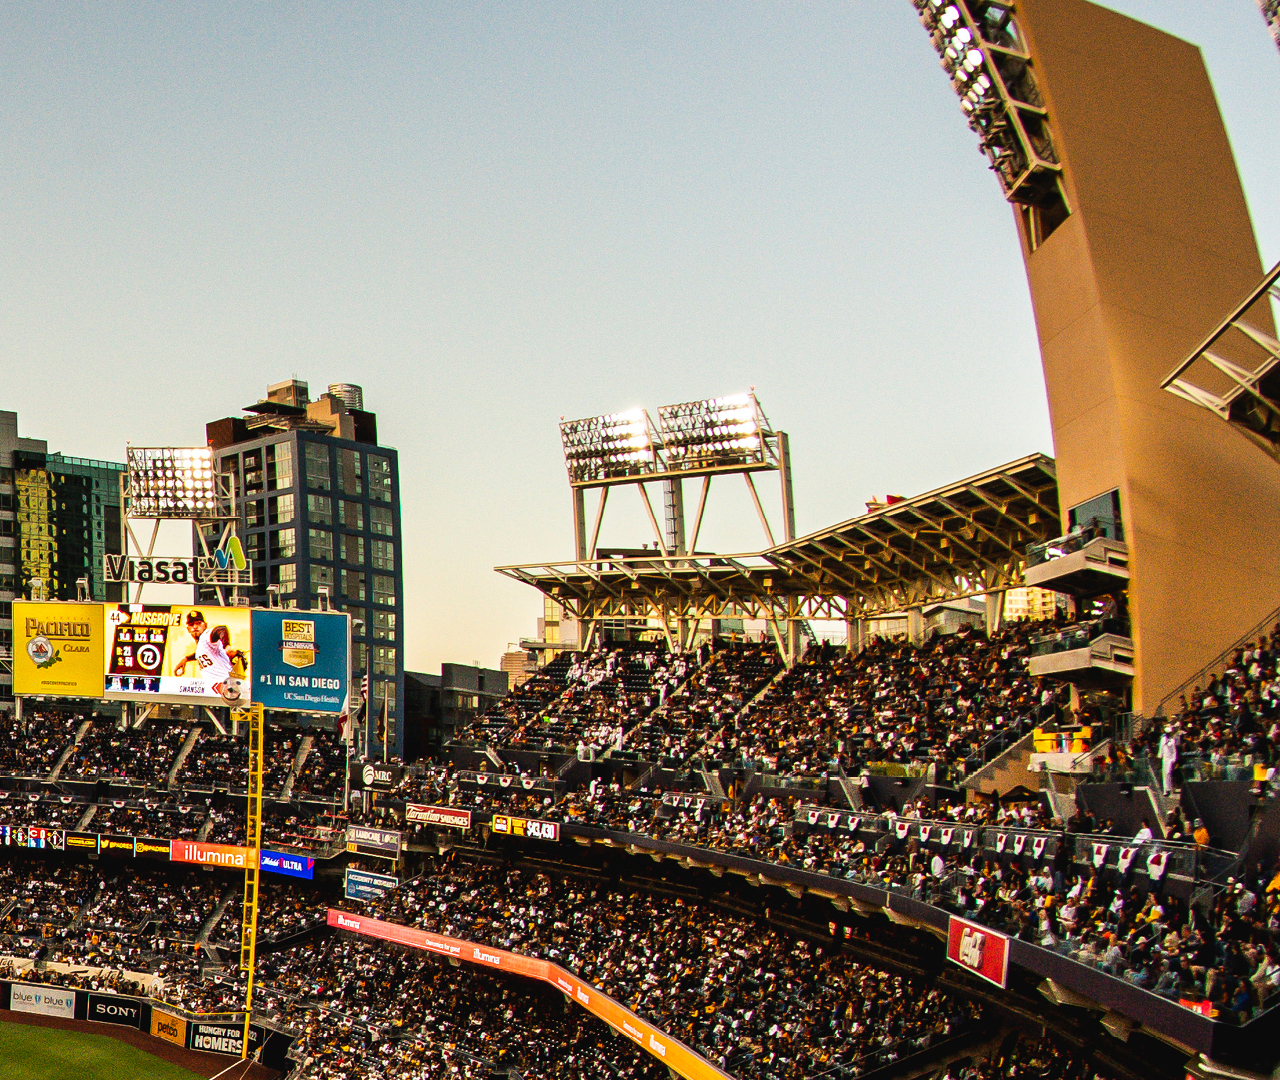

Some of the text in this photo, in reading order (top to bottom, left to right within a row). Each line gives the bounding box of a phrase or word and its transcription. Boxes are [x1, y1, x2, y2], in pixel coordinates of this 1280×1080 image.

[106, 554, 205, 584] Viasat
[109, 612, 180, 626] 44 MUSGROVE
[284, 622, 312, 634] BEST
[142, 651, 154, 664] 72
[260, 674, 340, 690] #1 IN SAN DIEGO
[179, 686, 204, 694] SWANSON
[440, 814, 468, 826] SAUSAGES
[356, 830, 380, 840] LANDCARE
[526, 822, 554, 840] $43,430
[185, 846, 243, 864] illumina
[283, 859, 302, 870] ULTRA
[473, 948, 500, 964] illumina
[13, 992, 64, 1006] blue blue
[96, 1004, 136, 1018] SONY
[157, 1020, 178, 1038] petco
[199, 1024, 240, 1038] HUNGRY FOR
[195, 1036, 242, 1054] HOMERS
